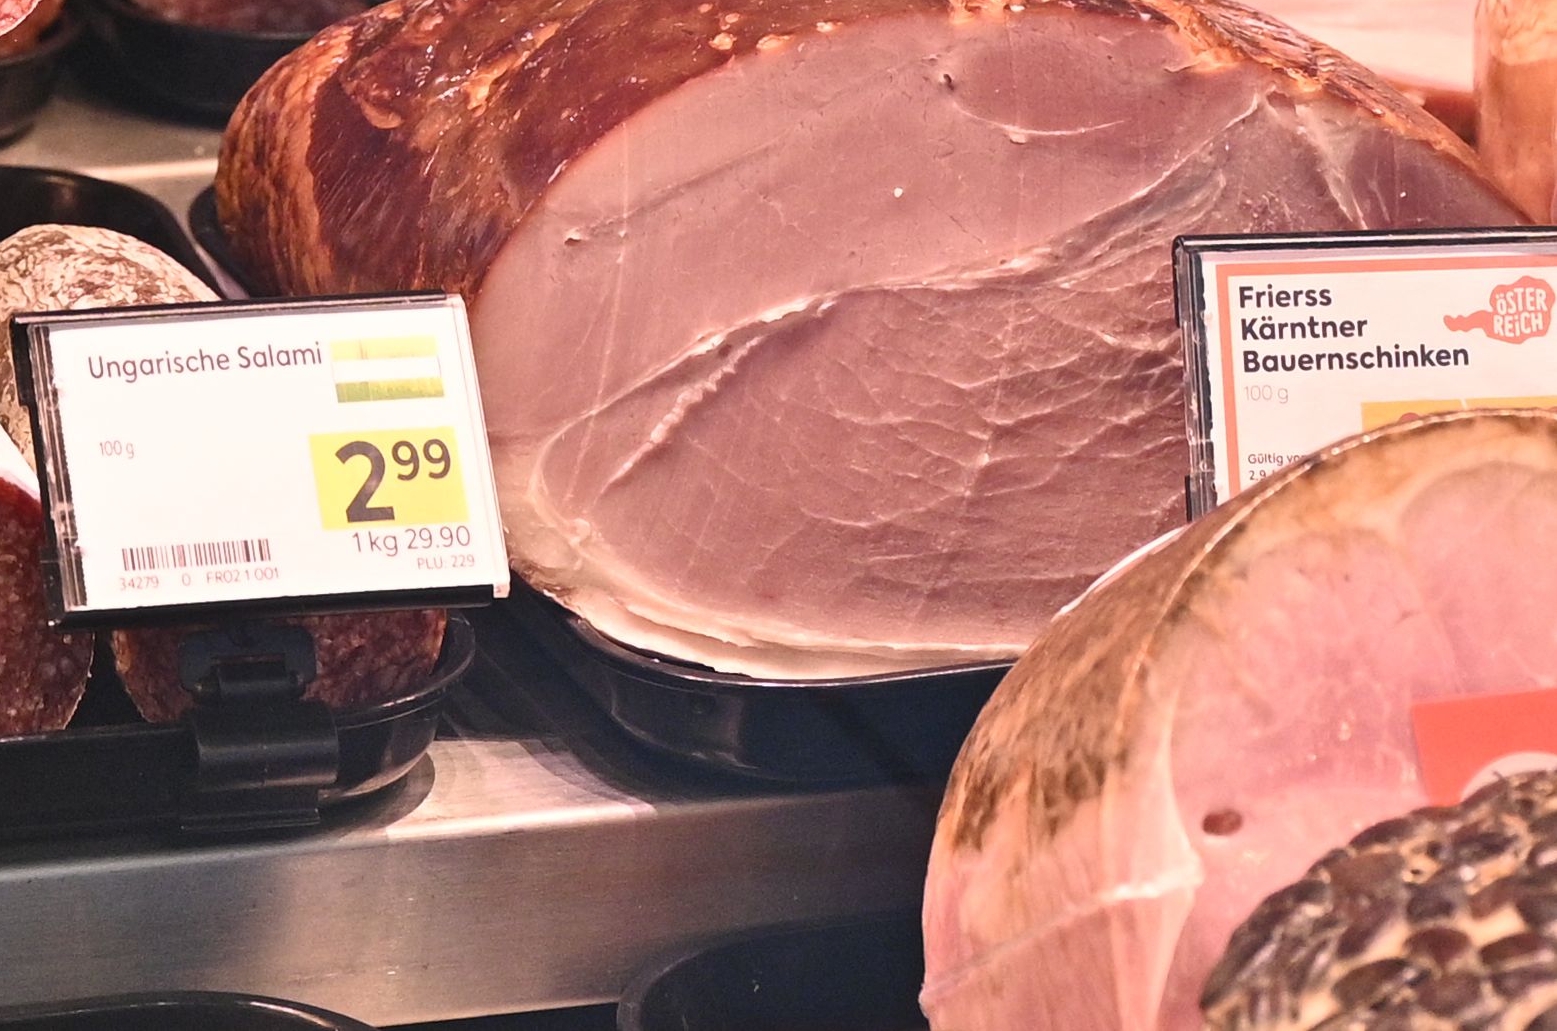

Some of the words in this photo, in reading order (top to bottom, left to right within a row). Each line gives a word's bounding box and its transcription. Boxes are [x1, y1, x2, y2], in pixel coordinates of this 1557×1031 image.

[1239, 283, 1332, 309] Frierss
[1240, 315, 1368, 341] Kärntner
[87, 347, 231, 383] Ungarische
[238, 341, 323, 369] Salami
[1243, 344, 1470, 374] Bauernschinken
[1244, 385, 1272, 401] 100
[99, 441, 122, 457] 100
[1247, 453, 1283, 466] Gültig
[370, 532, 399, 557] kg
[407, 525, 472, 551] 29.90
[451, 555, 476, 569] 229
[119, 575, 160, 591] 34279
